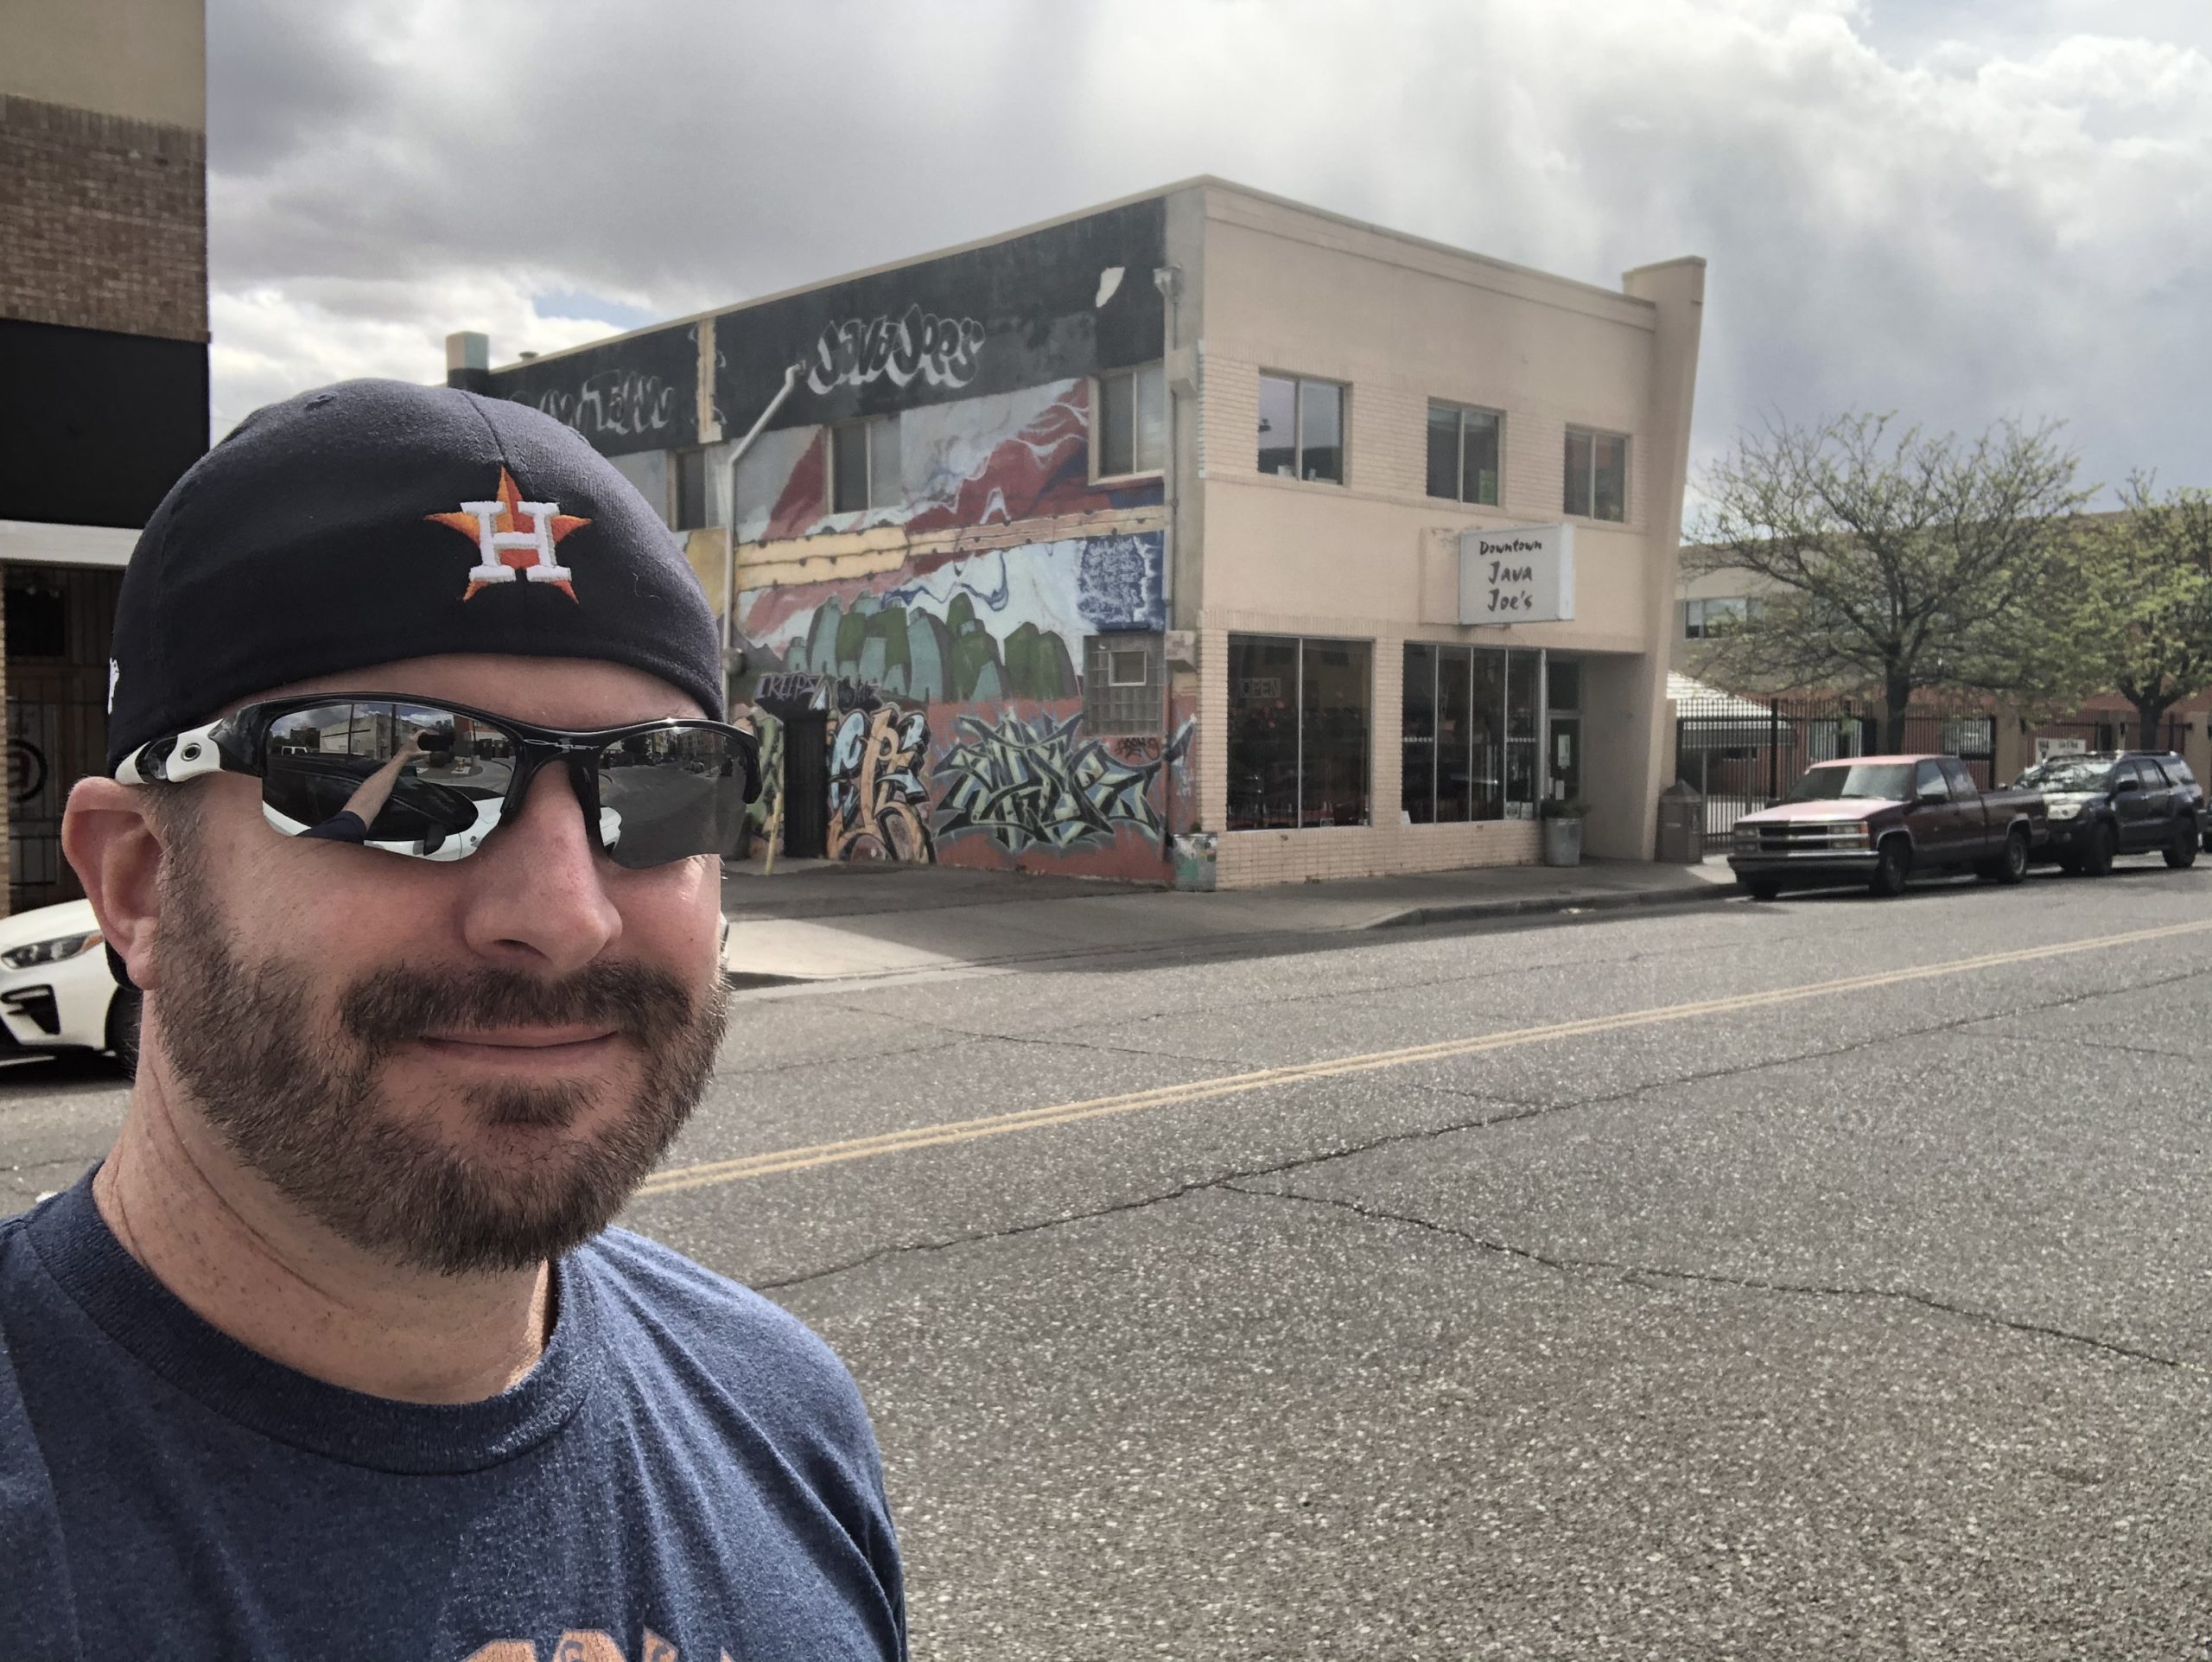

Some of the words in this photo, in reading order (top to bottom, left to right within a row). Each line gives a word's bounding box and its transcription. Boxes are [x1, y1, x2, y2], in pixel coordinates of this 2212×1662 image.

[461, 500, 572, 583] H
[1479, 539, 1542, 556] Downtown
[1487, 588, 1533, 612] Joe's
[1239, 678, 1281, 698] OPEN
